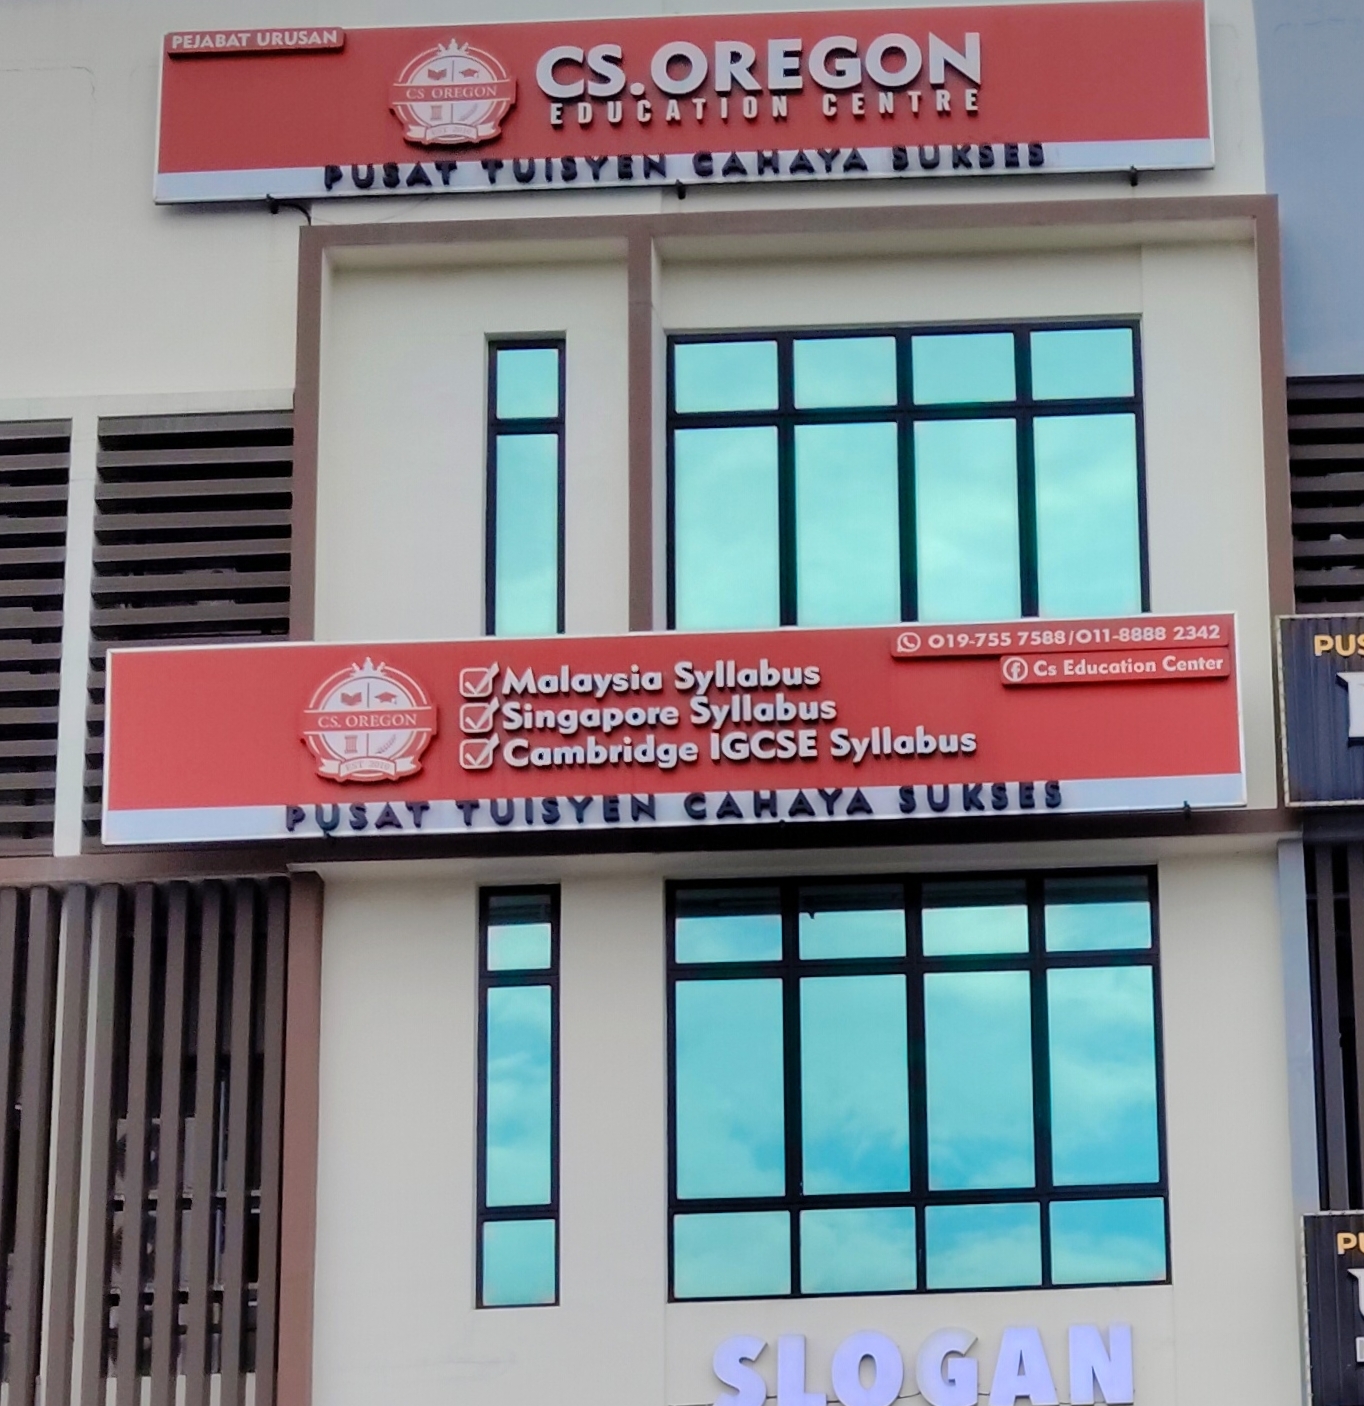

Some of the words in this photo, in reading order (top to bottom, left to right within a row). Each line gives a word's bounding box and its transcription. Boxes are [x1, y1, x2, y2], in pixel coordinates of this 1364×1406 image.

[171, 33, 250, 49] PEJABAT
[256, 29, 338, 46] URUSAN
[535, 31, 982, 99] CS.OREGON
[406, 87, 425, 99] CS
[431, 86, 498, 99] OREGON
[549, 95, 788, 126] EDUCATION
[822, 88, 980, 118] CENTRE
[325, 158, 458, 191] PUSAT
[481, 152, 667, 185] TUISYEN
[691, 147, 869, 178] CAHAYA
[891, 141, 1045, 172] SUKSES
[928, 630, 1012, 649] 019-755
[1173, 624, 1221, 641] 2342
[502, 663, 663, 698] Malaysia
[674, 658, 822, 695] Syllabus
[1033, 660, 1058, 677] Cs
[1063, 657, 1157, 676] Education
[1162, 655, 1224, 672] Center
[345, 713, 418, 728] OREGON
[502, 700, 680, 734] Singapore
[690, 695, 838, 729] Syllabus
[502, 735, 699, 770] Cambridge
[710, 730, 818, 761] IGCSE
[829, 724, 978, 764] Syllabus
[286, 801, 430, 833] PUSAT
[455, 793, 657, 828] TUISYEN
[683, 788, 874, 821] CAHAYA
[897, 780, 1062, 814] SUKSES
